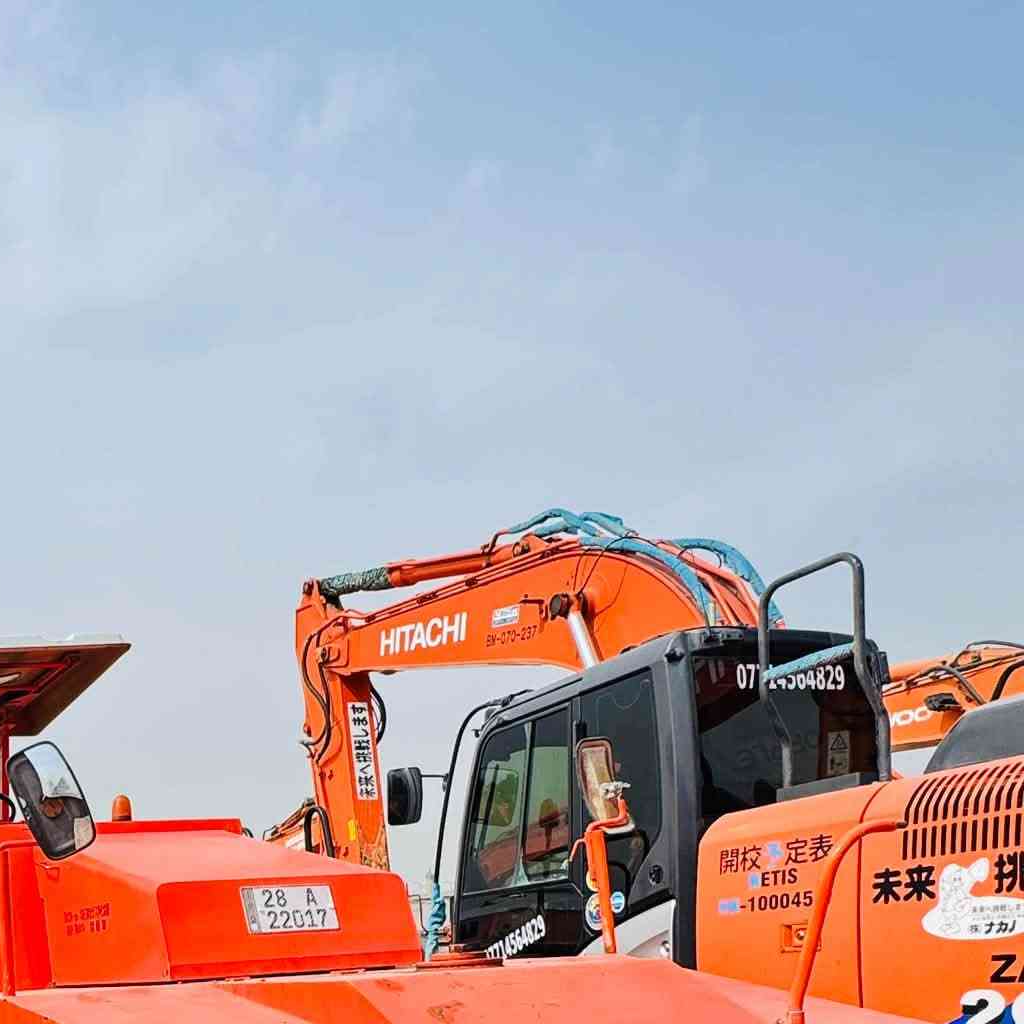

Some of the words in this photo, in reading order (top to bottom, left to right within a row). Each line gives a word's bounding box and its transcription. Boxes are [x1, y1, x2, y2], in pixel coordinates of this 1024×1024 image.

[379, 611, 468, 656] HITACHI
[737, 663, 845, 690] 071564829
[749, 868, 798, 887] ETIS
[262, 889, 287, 907] 28
[719, 890, 814, 912] -100045
[267, 909, 327, 929] 22017
[990, 954, 1024, 983] Z
